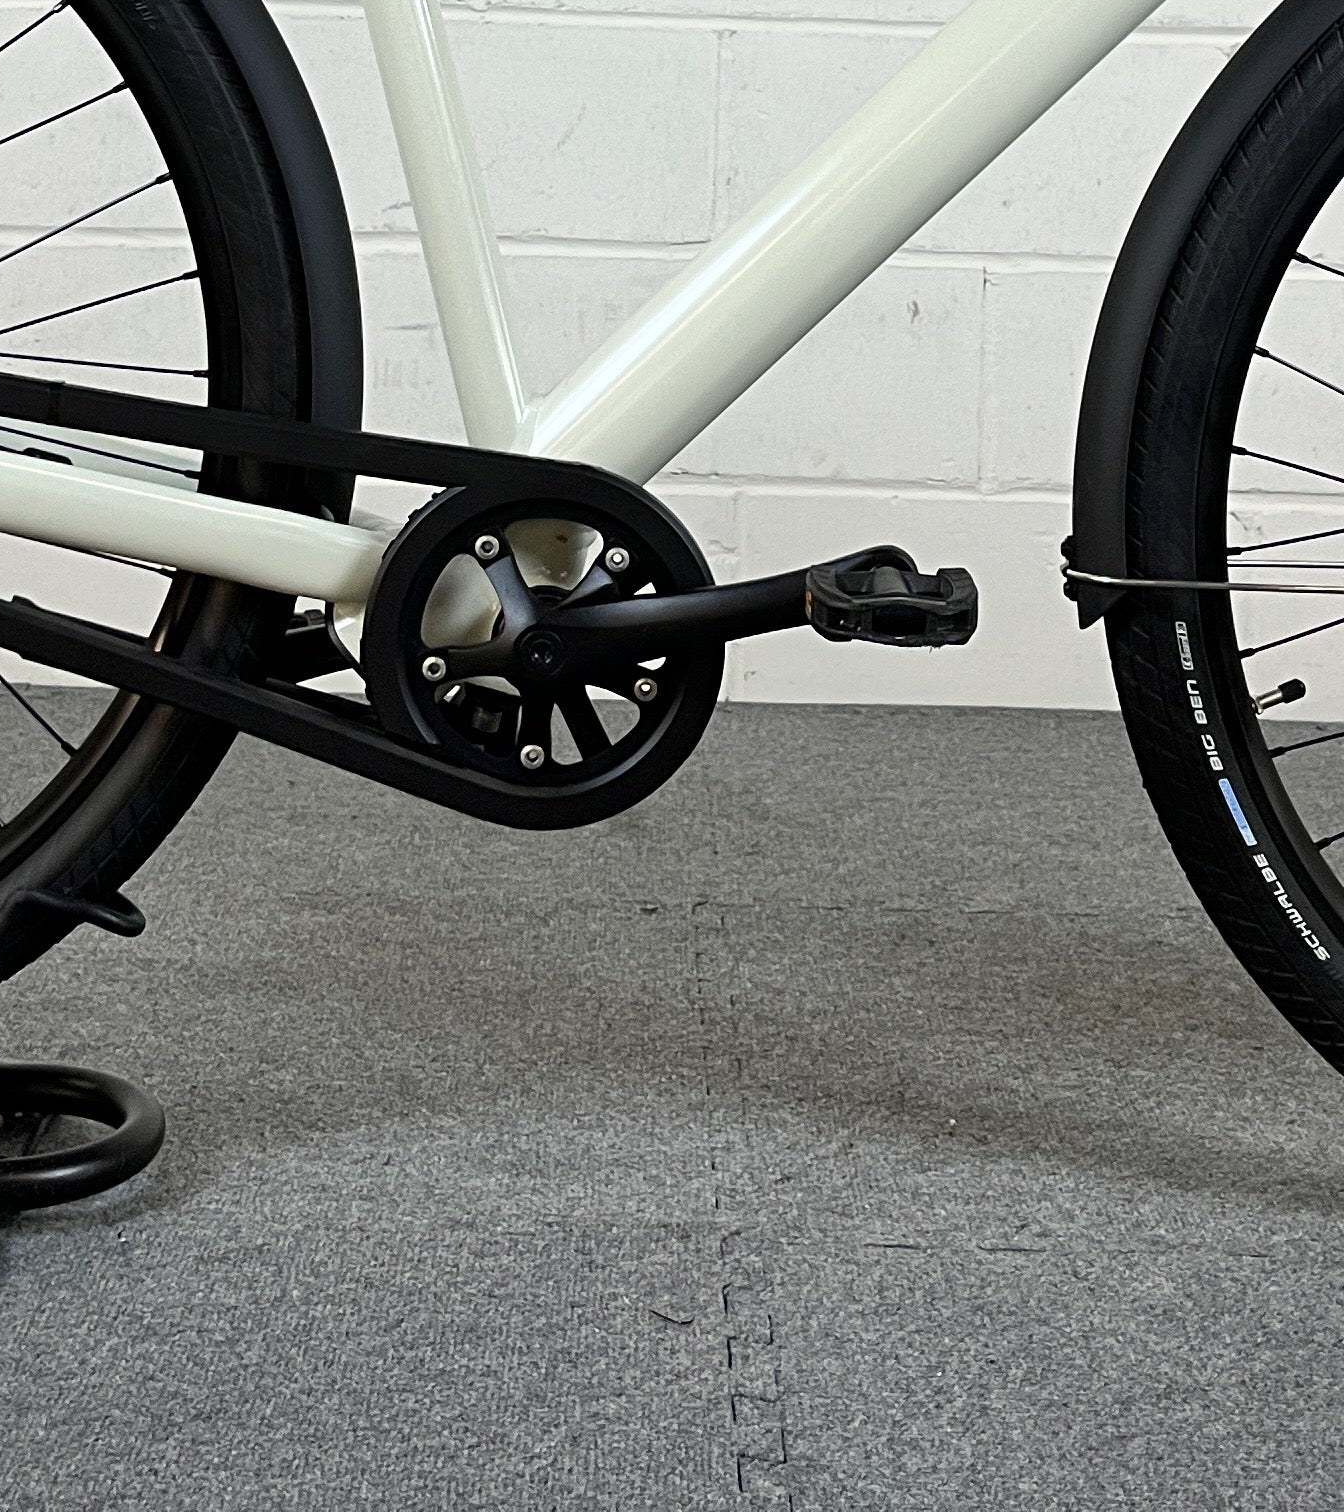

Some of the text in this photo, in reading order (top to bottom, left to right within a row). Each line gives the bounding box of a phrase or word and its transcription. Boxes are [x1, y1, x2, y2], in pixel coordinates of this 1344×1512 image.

[1186, 679, 1332, 962] SCHWALBE BIG BEN
